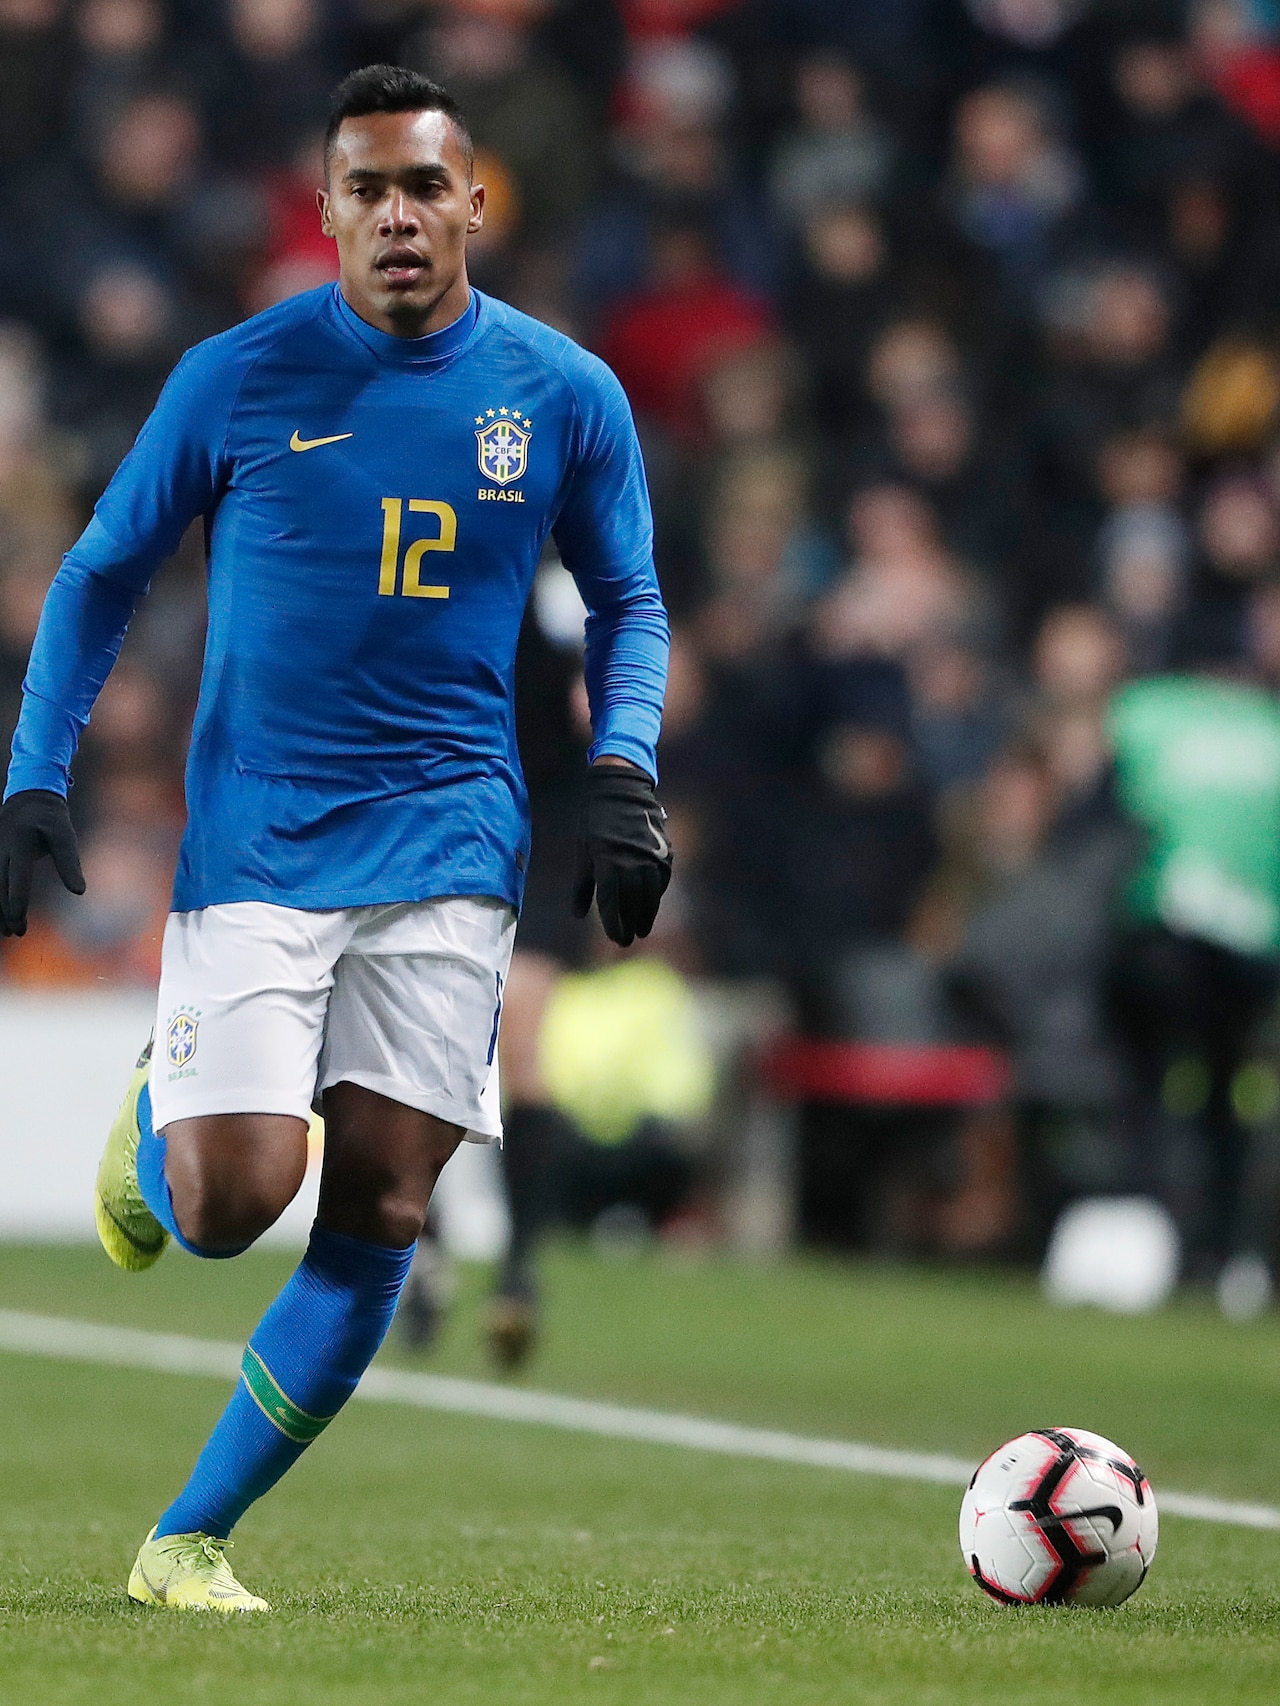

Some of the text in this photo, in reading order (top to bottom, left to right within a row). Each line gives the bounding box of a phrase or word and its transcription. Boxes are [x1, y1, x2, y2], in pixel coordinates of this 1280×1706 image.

[495, 447, 512, 455] CBF
[477, 489, 525, 502] BRASIL
[378, 497, 457, 599] 12
